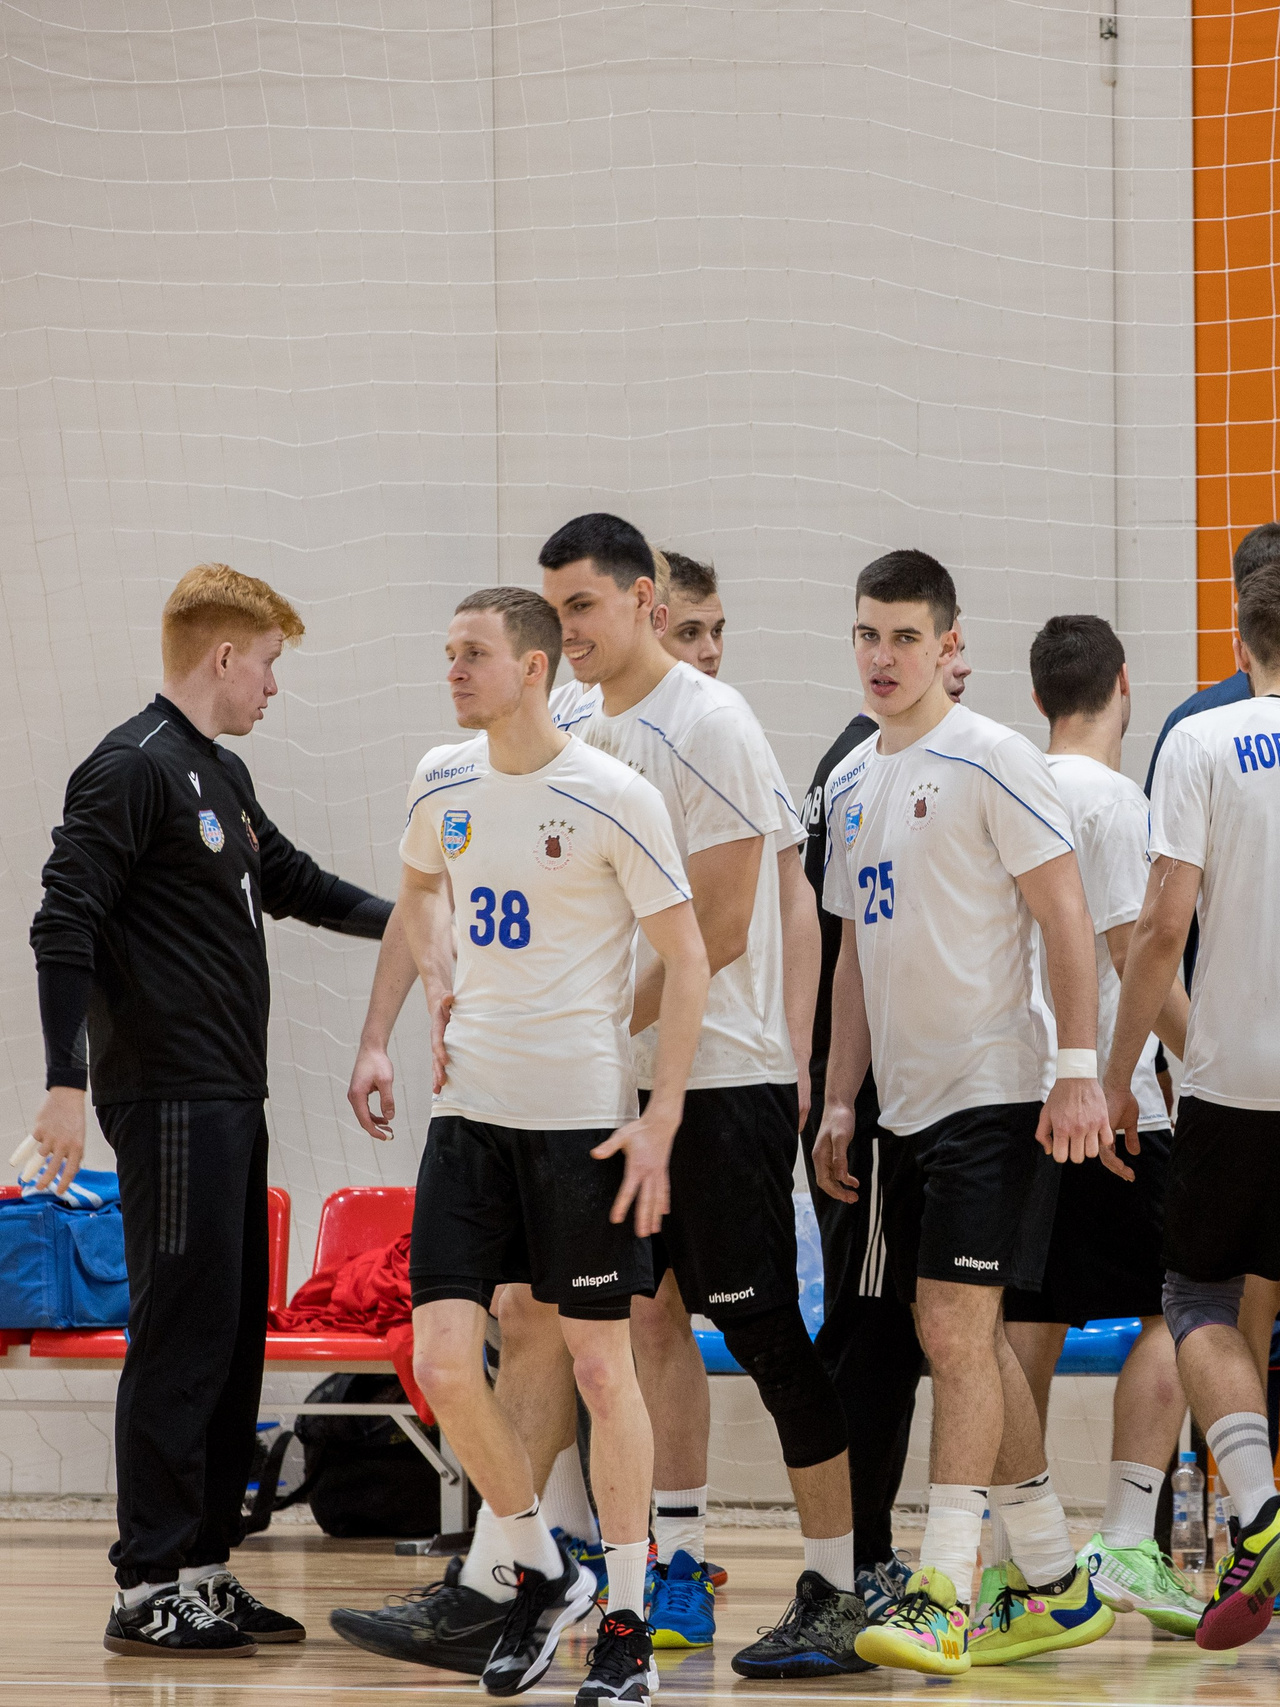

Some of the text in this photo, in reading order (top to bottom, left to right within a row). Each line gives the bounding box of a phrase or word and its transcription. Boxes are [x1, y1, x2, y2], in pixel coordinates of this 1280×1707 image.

[425, 763, 475, 782] uhlsport
[858, 861, 894, 925] 25
[470, 886, 531, 949] 38
[954, 1255, 1000, 1271] uhlsport
[572, 1270, 619, 1288] uhlsport
[708, 1286, 755, 1304] uhlsport
